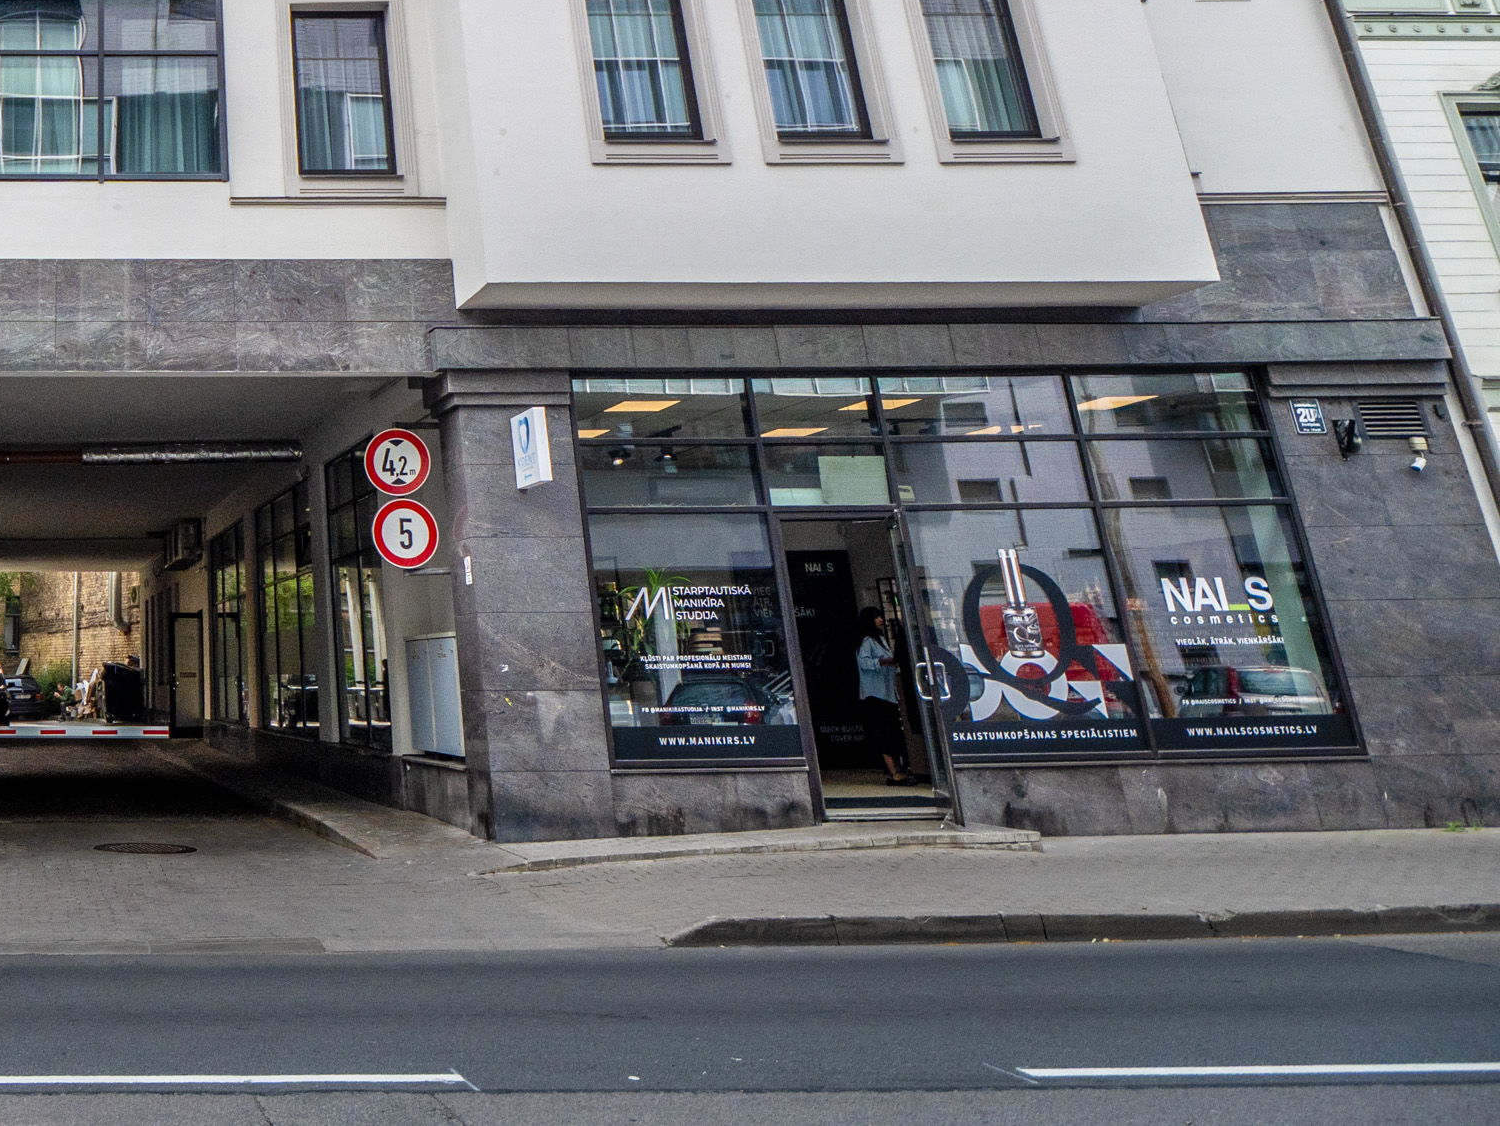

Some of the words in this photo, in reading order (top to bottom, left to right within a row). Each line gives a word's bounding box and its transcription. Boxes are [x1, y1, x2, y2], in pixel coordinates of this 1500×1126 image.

[382, 448, 408, 477] 4,2
[399, 518, 413, 550] 5
[672, 584, 751, 596] STARPTAUTISKĀ
[674, 598, 725, 608] MANIKĪRA
[676, 611, 718, 620] STUDIJA
[1170, 614, 1278, 625] cosmetics
[1176, 636, 1209, 646] VIEGLĀK,
[1210, 636, 1236, 646] ĀTRĀK,
[645, 662, 703, 670] SKAISTUMKOPŠANĀ
[953, 729, 1057, 741] SKAISTUMKOPŠANAS
[1061, 728, 1137, 739] SPECIĀLISTIEM
[1186, 725, 1317, 737] WWW.NAILSCOSMETICS.LV
[659, 736, 756, 745] WWW.MANIKIRS.LV
